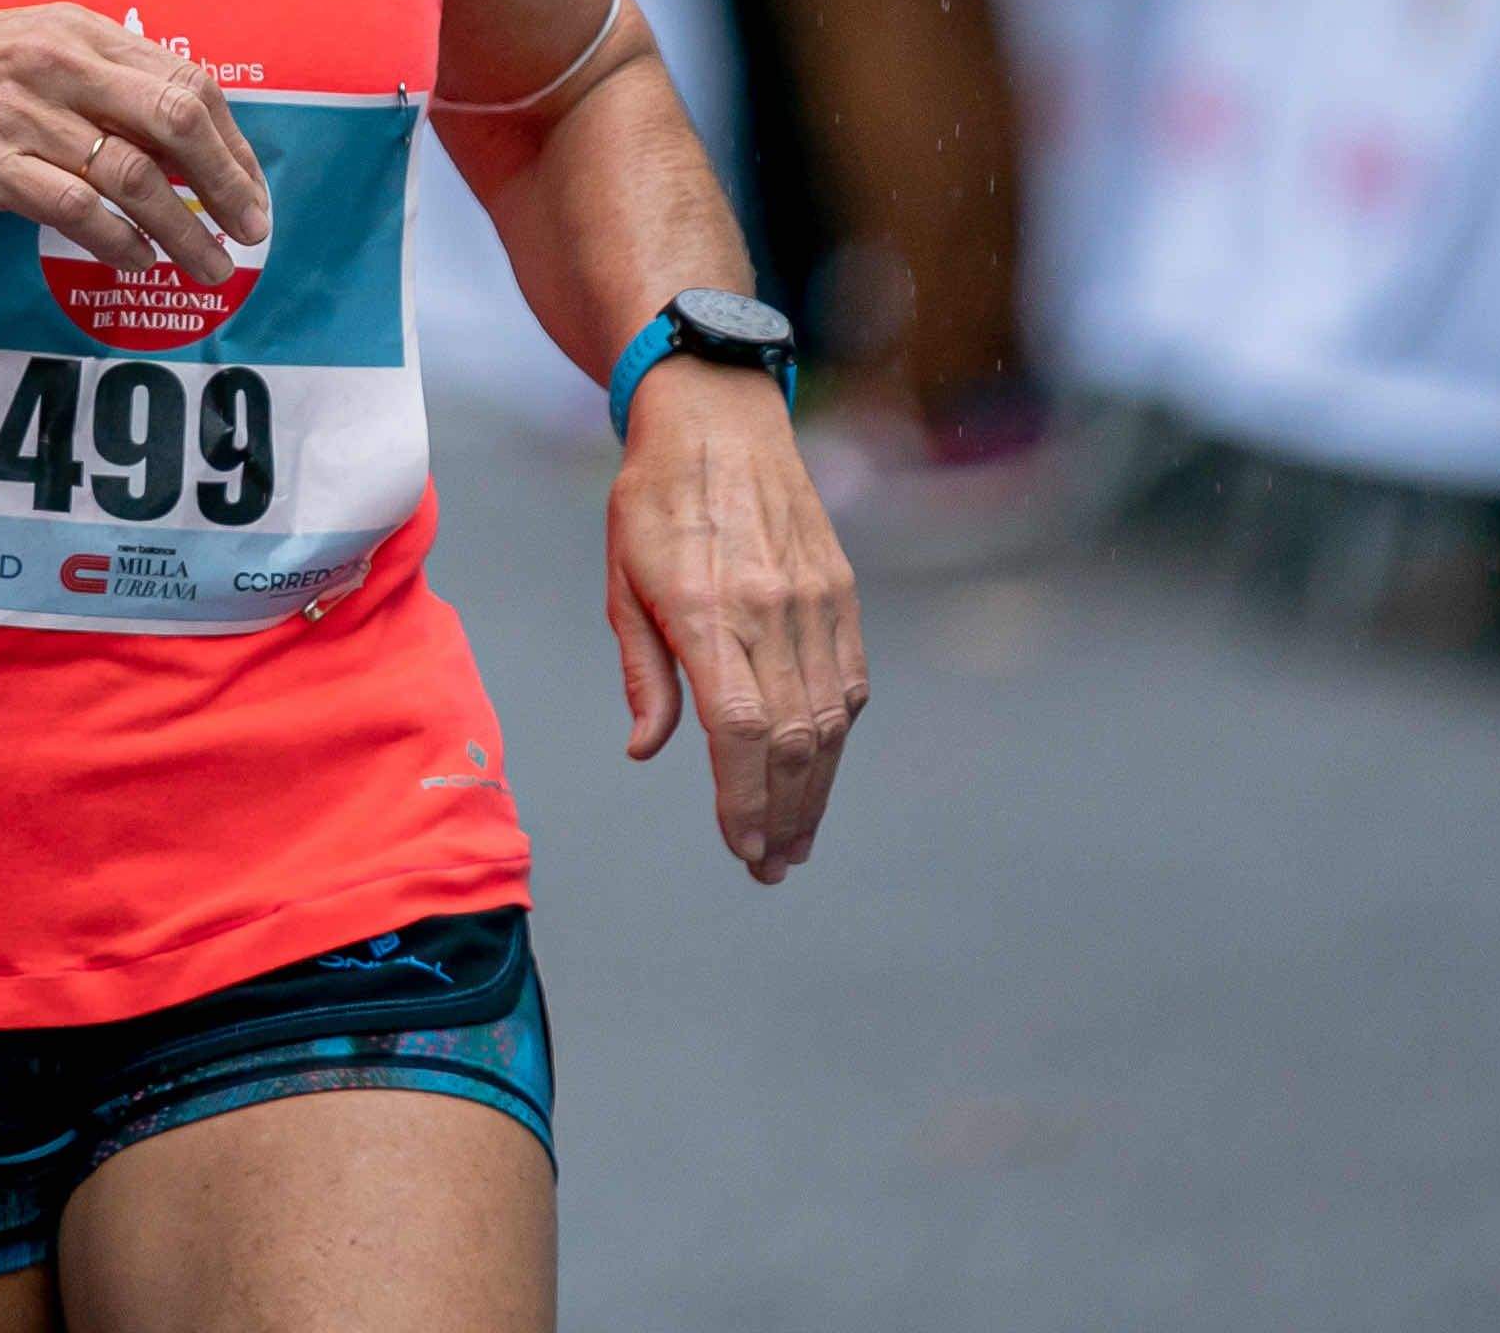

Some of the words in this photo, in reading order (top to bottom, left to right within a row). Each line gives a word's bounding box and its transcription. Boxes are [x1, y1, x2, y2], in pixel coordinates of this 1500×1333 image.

[92, 310, 115, 329] DE
[118, 310, 205, 332] MADRID
[115, 556, 189, 579] MILLA
[113, 577, 198, 602] URBANA
